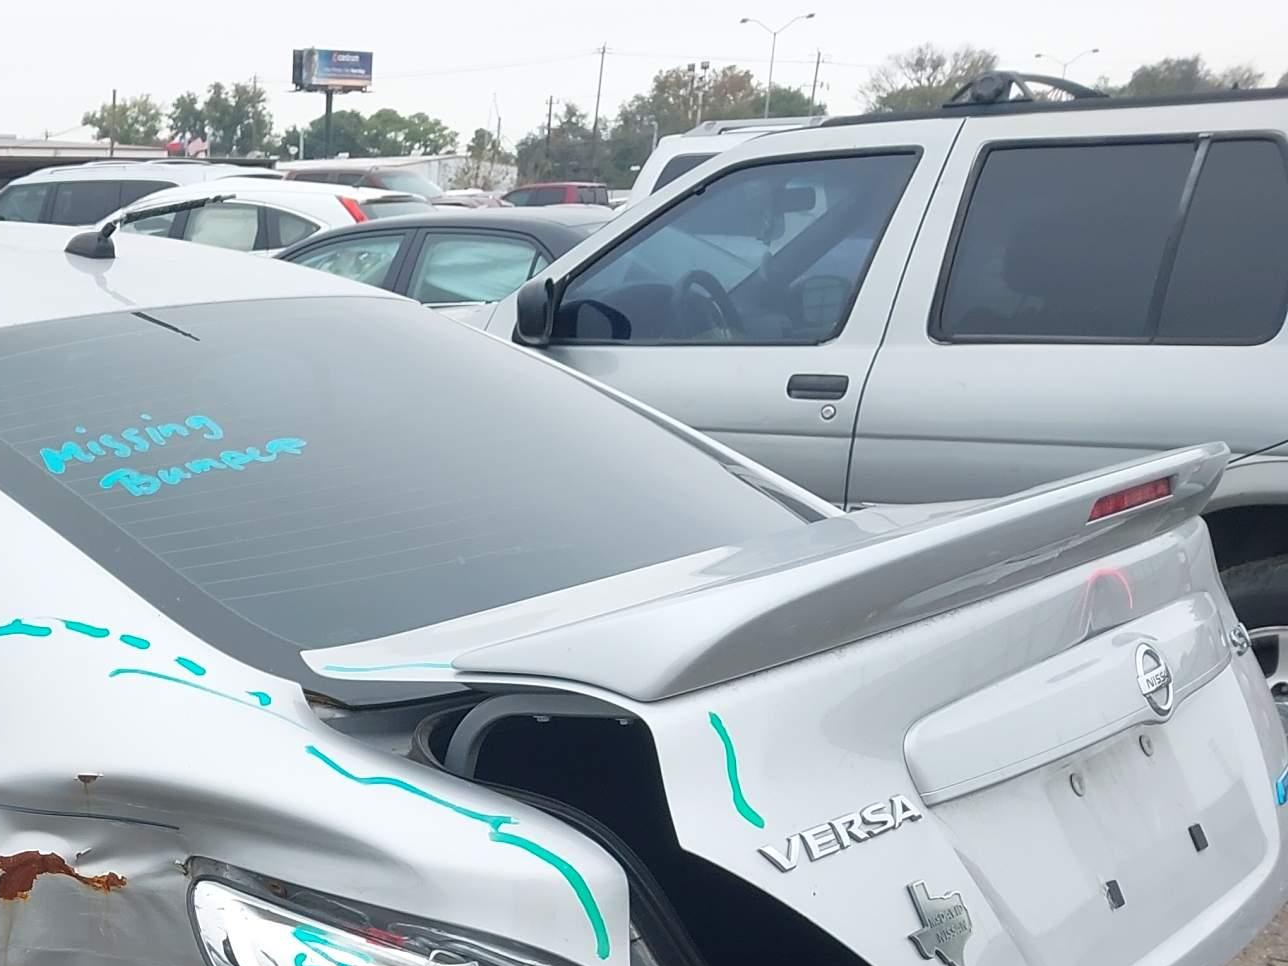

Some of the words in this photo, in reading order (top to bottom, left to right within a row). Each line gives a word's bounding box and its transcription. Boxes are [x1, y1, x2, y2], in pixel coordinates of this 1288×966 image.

[40, 413, 224, 474] Missing
[757, 794, 923, 873] VERSA
[935, 920, 968, 944] NISSAN
